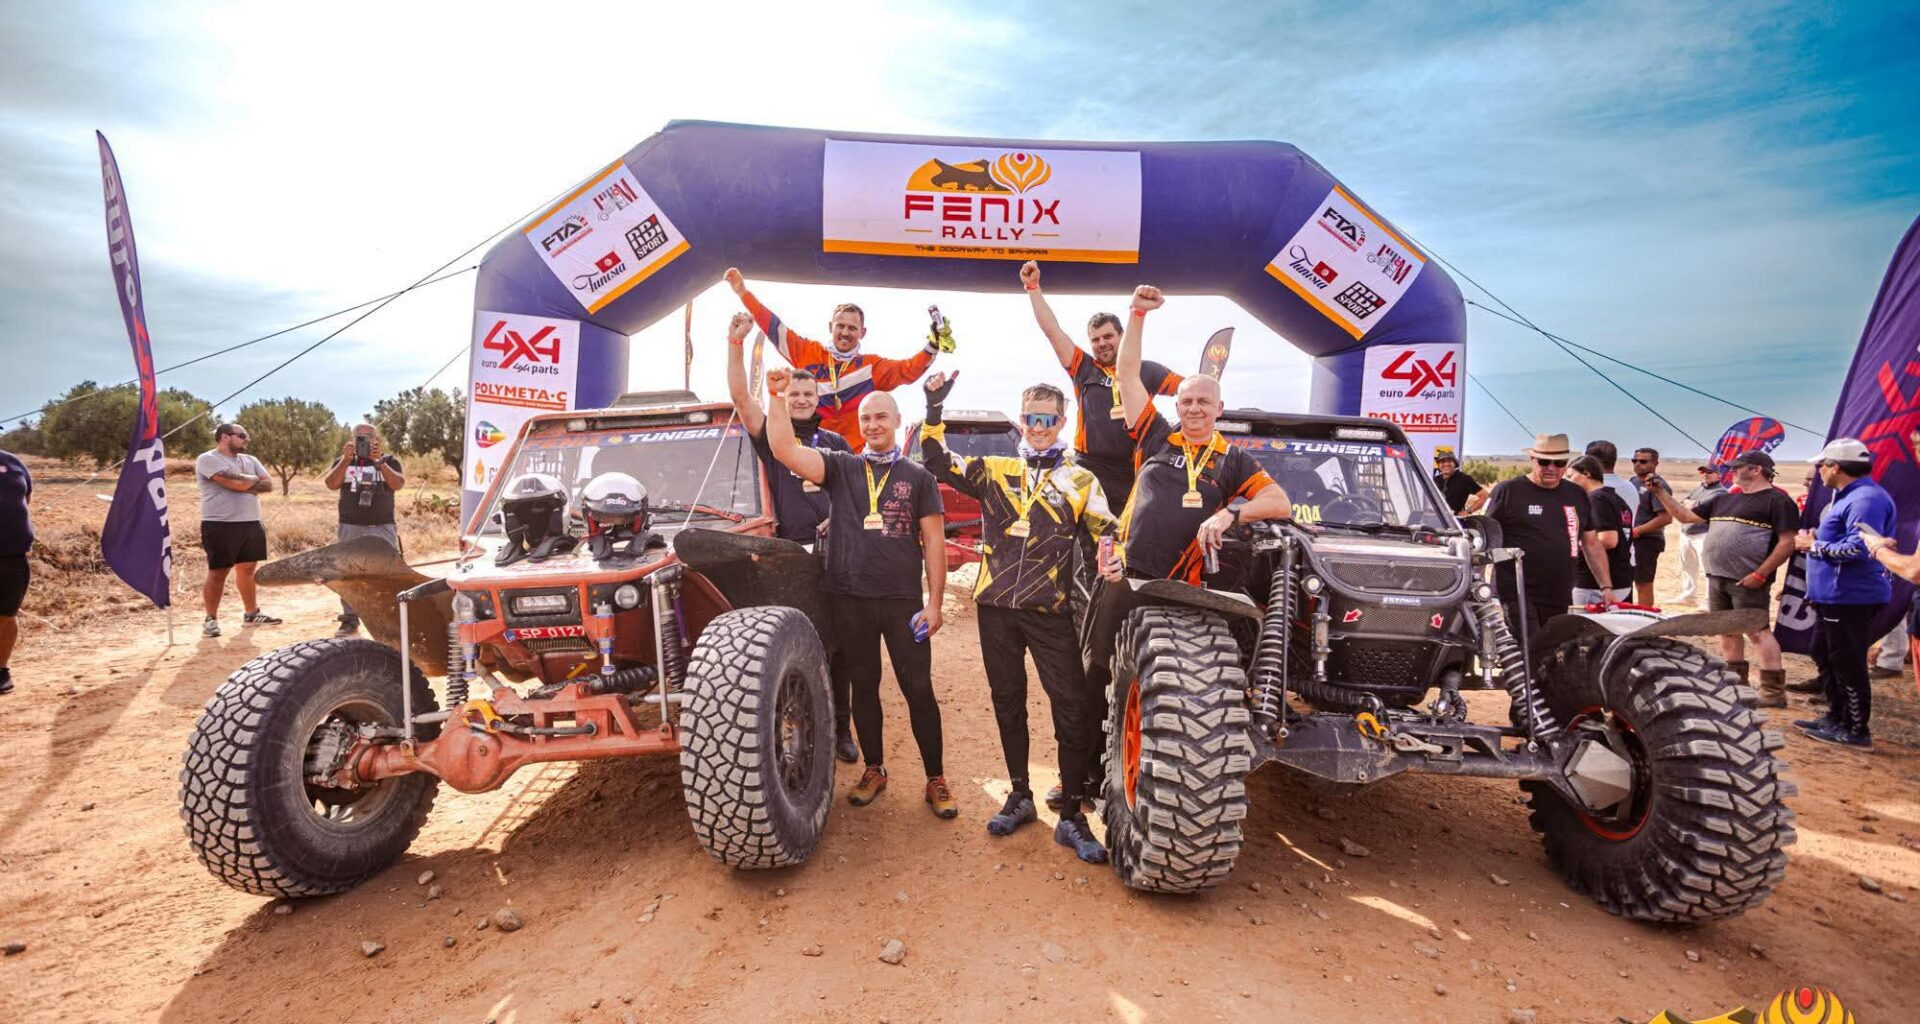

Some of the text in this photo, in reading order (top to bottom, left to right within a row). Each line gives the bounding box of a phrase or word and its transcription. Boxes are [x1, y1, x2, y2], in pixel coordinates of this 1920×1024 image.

[904, 194, 1061, 225] FENIX
[941, 225, 1025, 241] RALLY
[1322, 206, 1358, 242] FTA
[637, 233, 666, 259] SPORT
[1289, 245, 1328, 290] Tunisia
[571, 263, 628, 294] Tunisia
[1336, 294, 1369, 320] SPORT
[481, 360, 498, 369] euro
[531, 365, 560, 375] parts
[1379, 389, 1404, 398] euro
[1436, 390, 1455, 400] parts
[628, 428, 720, 443] TUNISIA
[1290, 440, 1383, 456] TUNISIA
[1292, 503, 1322, 524] 204
[519, 625, 585, 639] SP 0127
